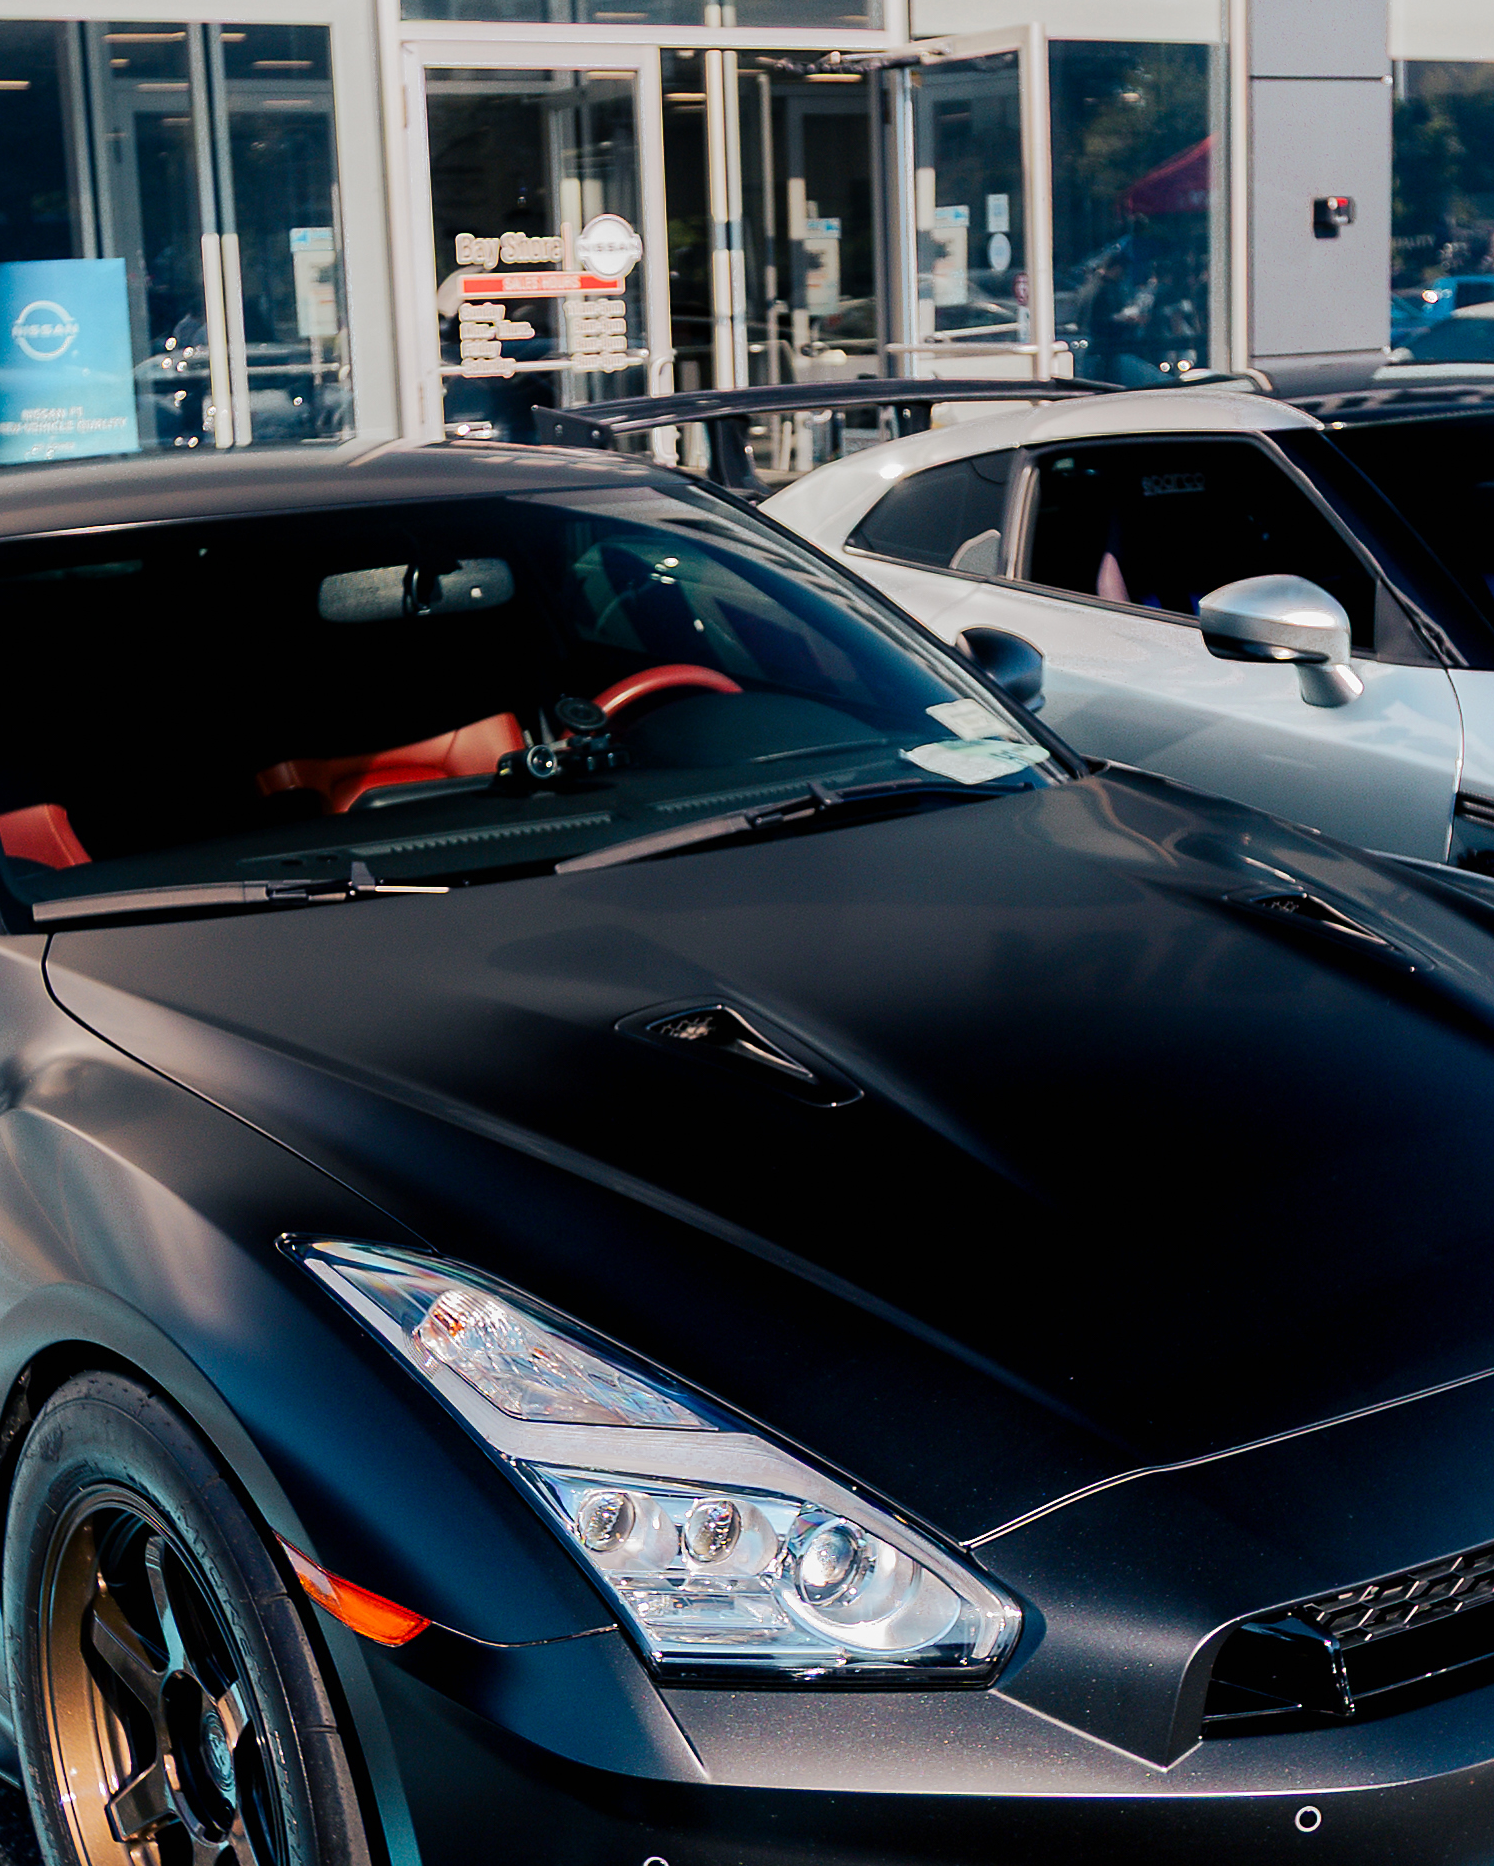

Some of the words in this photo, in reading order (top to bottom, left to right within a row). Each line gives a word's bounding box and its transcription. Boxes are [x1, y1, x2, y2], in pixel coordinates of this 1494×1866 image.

[456, 233, 500, 269] Bay
[576, 241, 642, 254] NISSAN
[12, 322, 79, 338] NISSAN
